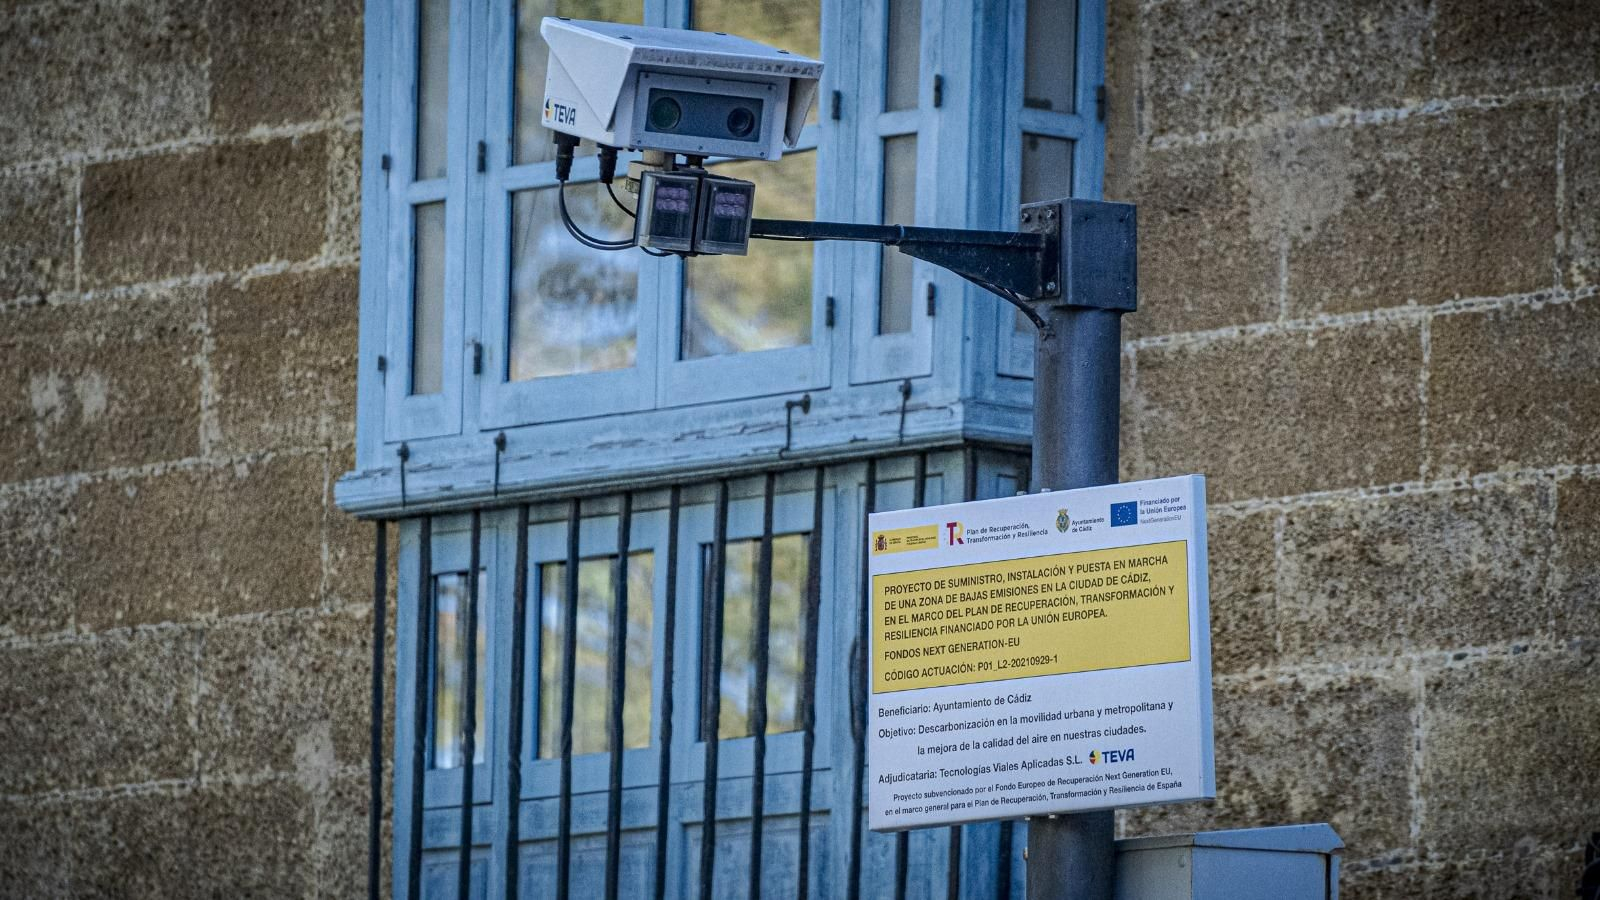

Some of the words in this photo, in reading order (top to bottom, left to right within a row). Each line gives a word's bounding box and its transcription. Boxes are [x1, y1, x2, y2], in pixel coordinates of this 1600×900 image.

[554, 104, 576, 126] TEVA
[967, 534, 1010, 544] Transformación
[1017, 529, 1048, 537] Resiliencia
[989, 523, 1030, 532] Recuperación,
[1072, 518, 1104, 526] Ayuntamiento
[885, 582, 932, 595] PROYECTO
[934, 580, 946, 590] DE
[948, 574, 1005, 588] SUMINISTRO,
[1008, 566, 1066, 581] INSTALACIÓN
[1068, 565, 1074, 575] Y
[1077, 562, 1111, 574] PUESTA
[1114, 560, 1125, 570] EN
[1128, 555, 1168, 568] MARCHA
[885, 601, 896, 611] DE
[899, 598, 917, 609] UNA
[919, 596, 943, 607] ZONA
[946, 594, 957, 604] DE
[960, 590, 988, 602] BAJAS
[990, 585, 1038, 598] EMISIONES
[1041, 583, 1052, 593] EN
[1056, 582, 1066, 592] LA
[1069, 578, 1103, 590] CIUDAD
[1106, 576, 1118, 586] DE
[1121, 572, 1151, 584] CÁDIZ,
[885, 616, 896, 626] EN
[899, 614, 909, 625] EL
[911, 610, 943, 623] MARCO
[946, 609, 963, 619] DEL
[966, 606, 988, 617] PLAN
[991, 604, 1003, 614] DE
[1005, 596, 1078, 612] RECUPERACIÓN,
[1080, 586, 1166, 604] TRANSFORMACIÓN
[1168, 585, 1174, 595] Y
[885, 627, 938, 641] RESILIENCIA
[940, 620, 994, 635] FINANCIADO
[997, 618, 1015, 629] POR
[1018, 617, 1029, 627] LA
[1031, 613, 1059, 625] UNIÓN
[1063, 609, 1107, 622] EUROPEA.
[885, 648, 920, 660] FONDOS
[923, 645, 946, 656] NEXT
[948, 638, 1020, 653] GENERATION-EU
[885, 669, 919, 681] CÓDIGO
[921, 662, 975, 677] ACTUACIÓN:
[978, 655, 1057, 671] P01_L2-20210929-1
[879, 704, 930, 718] Beneficiario:
[933, 698, 991, 713] Ayuntamiento
[994, 696, 1005, 705] de
[1007, 693, 1032, 704] Cádiz
[879, 727, 915, 739] Objetivo:
[919, 718, 994, 734] Descarbonización
[1010, 716, 1017, 725] la
[1020, 711, 1061, 724] movilidad
[1064, 710, 1094, 719] urbana
[1097, 708, 1102, 718] y
[1105, 703, 1165, 715] metropolitana
[1168, 702, 1173, 711] y
[918, 746, 925, 755] la
[927, 744, 957, 755] mejora
[960, 742, 970, 751] de
[973, 740, 980, 750] la
[983, 737, 1014, 749] calidad
[1016, 735, 1029, 745] del
[1032, 734, 1048, 744] aire
[1050, 734, 1061, 742] en
[1064, 730, 1101, 740] nuestras
[1104, 725, 1146, 736] ciudades.
[878, 770, 937, 784] Adjudicataria:
[939, 765, 991, 777] Tecnologías
[993, 762, 1019, 772] Viales
[1021, 758, 1064, 771] Aplicadas
[1066, 755, 1082, 766] S.L.
[1102, 748, 1135, 763] TEVA
[894, 792, 922, 802] Proyecto
[924, 787, 973, 798] subvencionado
[988, 784, 993, 792] el
[995, 783, 1016, 791] Fondo
[1018, 781, 1045, 789] Europeo
[1057, 775, 1103, 785] Recuperación
[1122, 770, 1159, 779] Generation
[1161, 768, 1172, 776] EU,
[925, 802, 949, 814] general
[951, 802, 965, 811] para
[1001, 794, 1048, 804] Recuperación,
[1050, 789, 1102, 800] Transformación
[1109, 784, 1145, 794] Resiliencia
[1147, 783, 1155, 791] de
[1157, 781, 1182, 790] España
